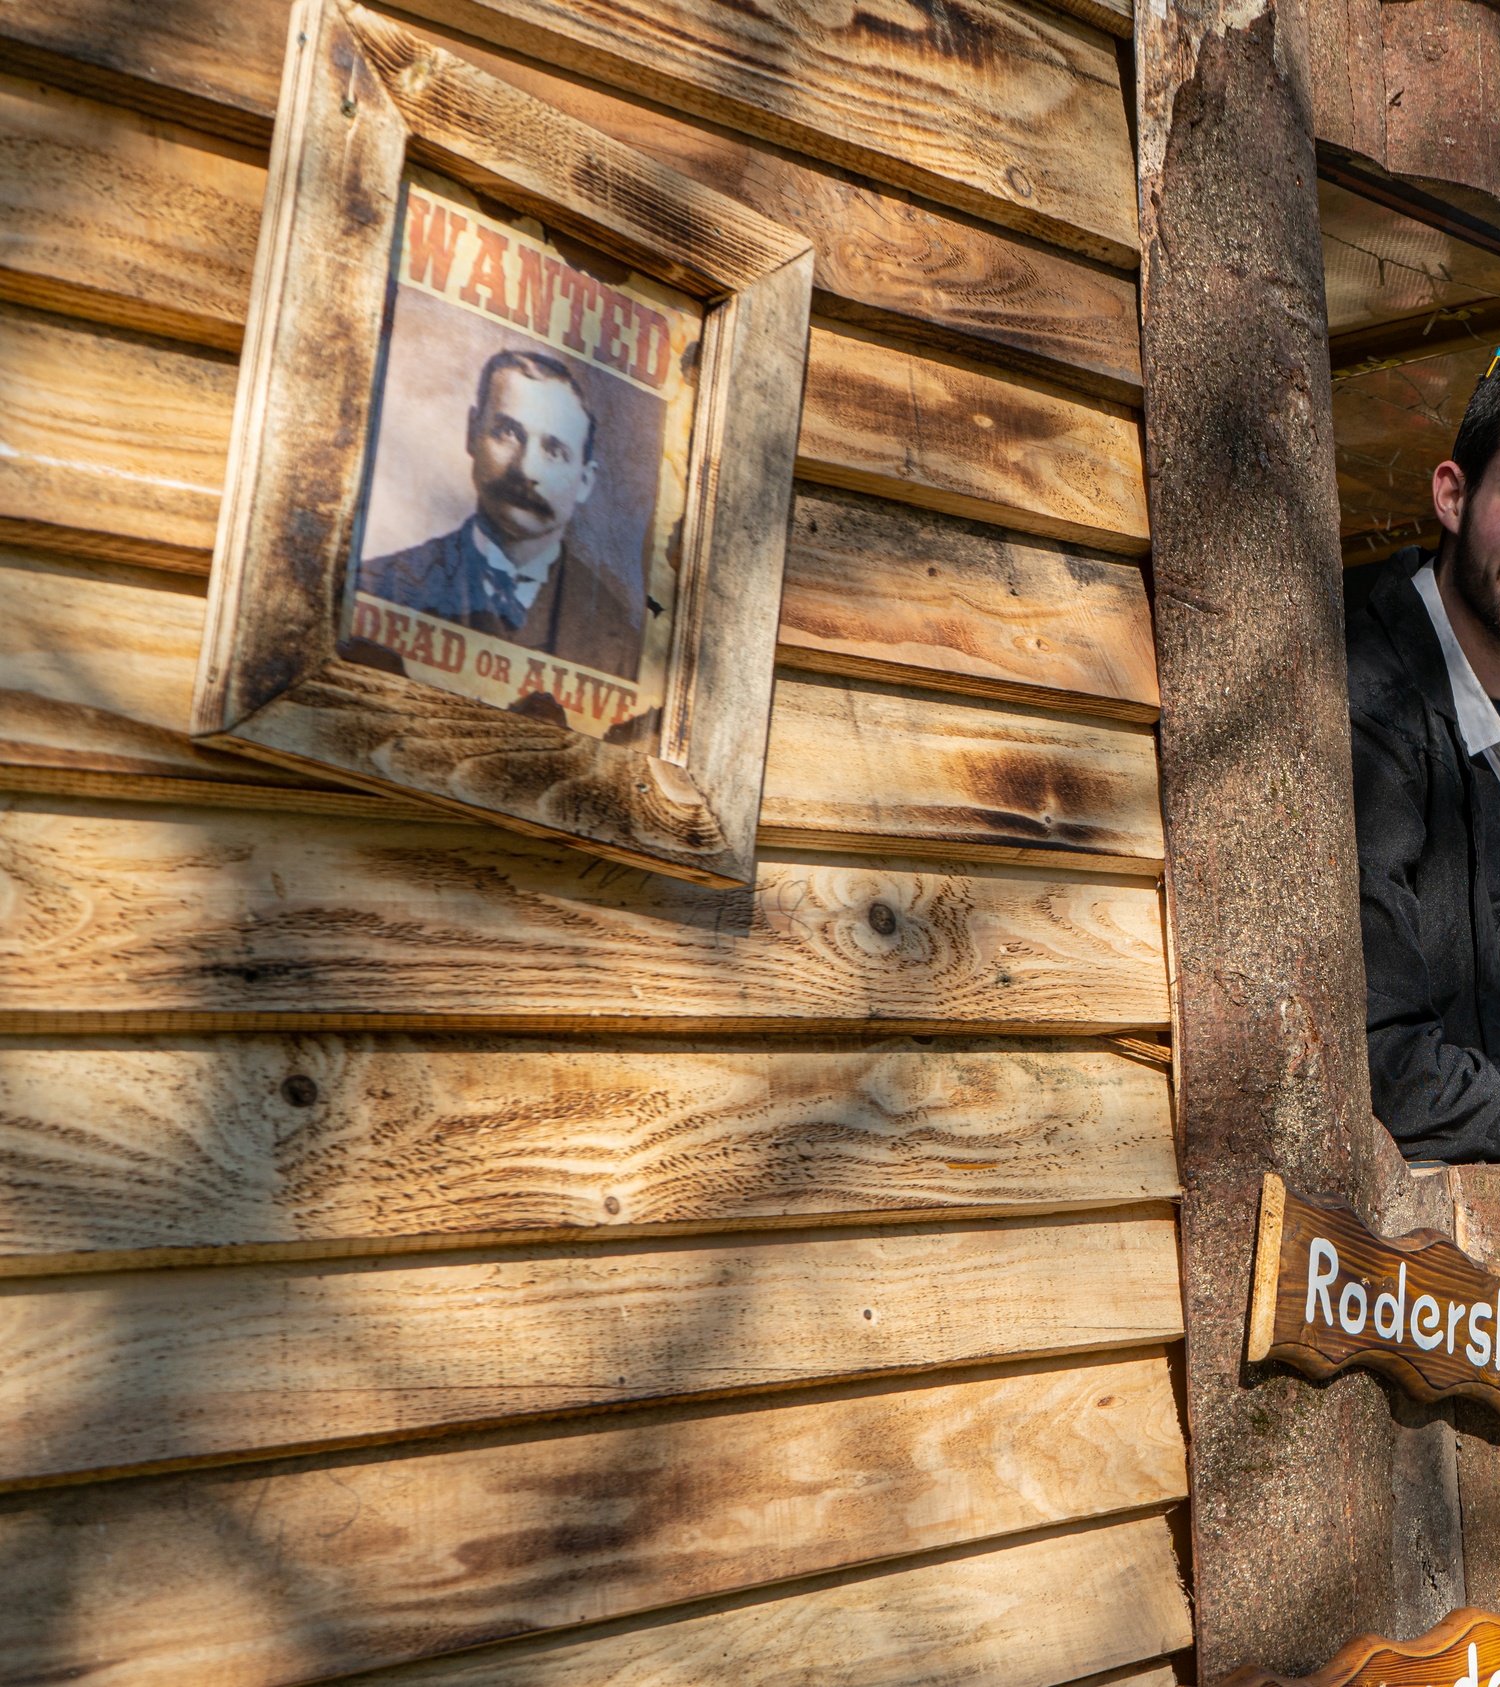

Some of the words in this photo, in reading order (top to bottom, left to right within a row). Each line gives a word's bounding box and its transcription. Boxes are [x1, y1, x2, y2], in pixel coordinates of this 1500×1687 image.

[408, 192, 671, 390] WANTED
[352, 602, 466, 674] DEAD
[476, 650, 512, 684] OR
[518, 657, 638, 725] ALIVE
